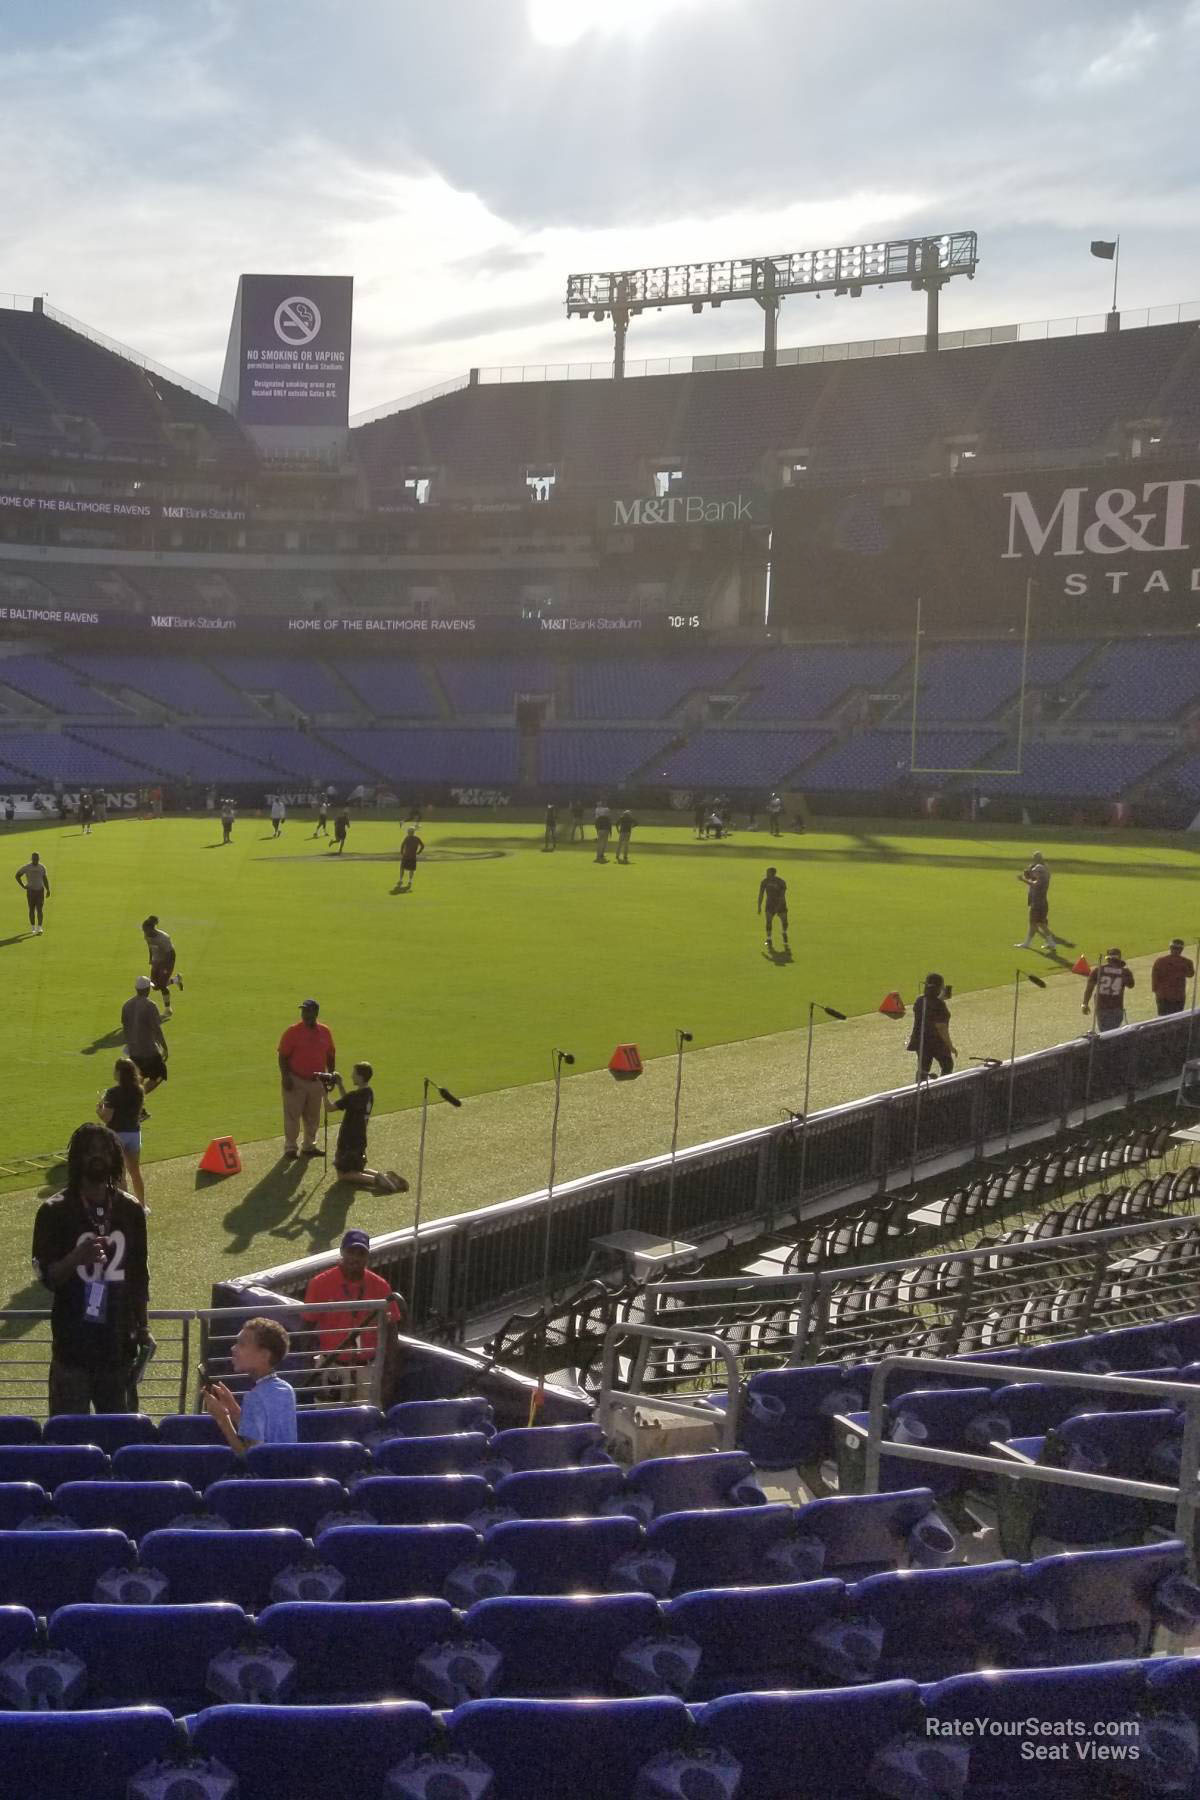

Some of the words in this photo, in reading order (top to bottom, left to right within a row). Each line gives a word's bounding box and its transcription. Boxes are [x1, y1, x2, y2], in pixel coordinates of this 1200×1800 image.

[247, 350, 259, 360] NO
[261, 350, 299, 361] SMOKING
[301, 351, 312, 361] OR
[315, 351, 345, 362] VAPING
[23, 498, 36, 509] OF
[38, 499, 56, 511] THE
[58, 500, 111, 514] BALTIMORE
[113, 504, 151, 516] RAVENS
[161, 506, 186, 519] M&T
[186, 508, 208, 519] Bank
[209, 508, 246, 521] Stadium
[613, 496, 682, 527] M&T
[686, 494, 752, 523] Bank
[1001, 479, 1200, 559] M&T
[9, 608, 62, 621] BALTIMORE
[63, 611, 99, 624] RAVENS
[150, 614, 174, 628] M&T
[174, 616, 196, 629] Bank
[197, 617, 236, 630] Stadium
[540, 618, 569, 630] M&T
[569, 618, 596, 630] Bank
[597, 618, 642, 630] Stadium
[668, 616, 700, 628] 70:15
[288, 619, 321, 631] HOME
[324, 619, 339, 631] OF
[342, 619, 363, 631] THE
[365, 619, 428, 631] BALTIMORE
[431, 619, 476, 631] RAVENS
[1099, 976, 1123, 996] 24
[623, 1047, 641, 1066] 10
[218, 1141, 238, 1169] G
